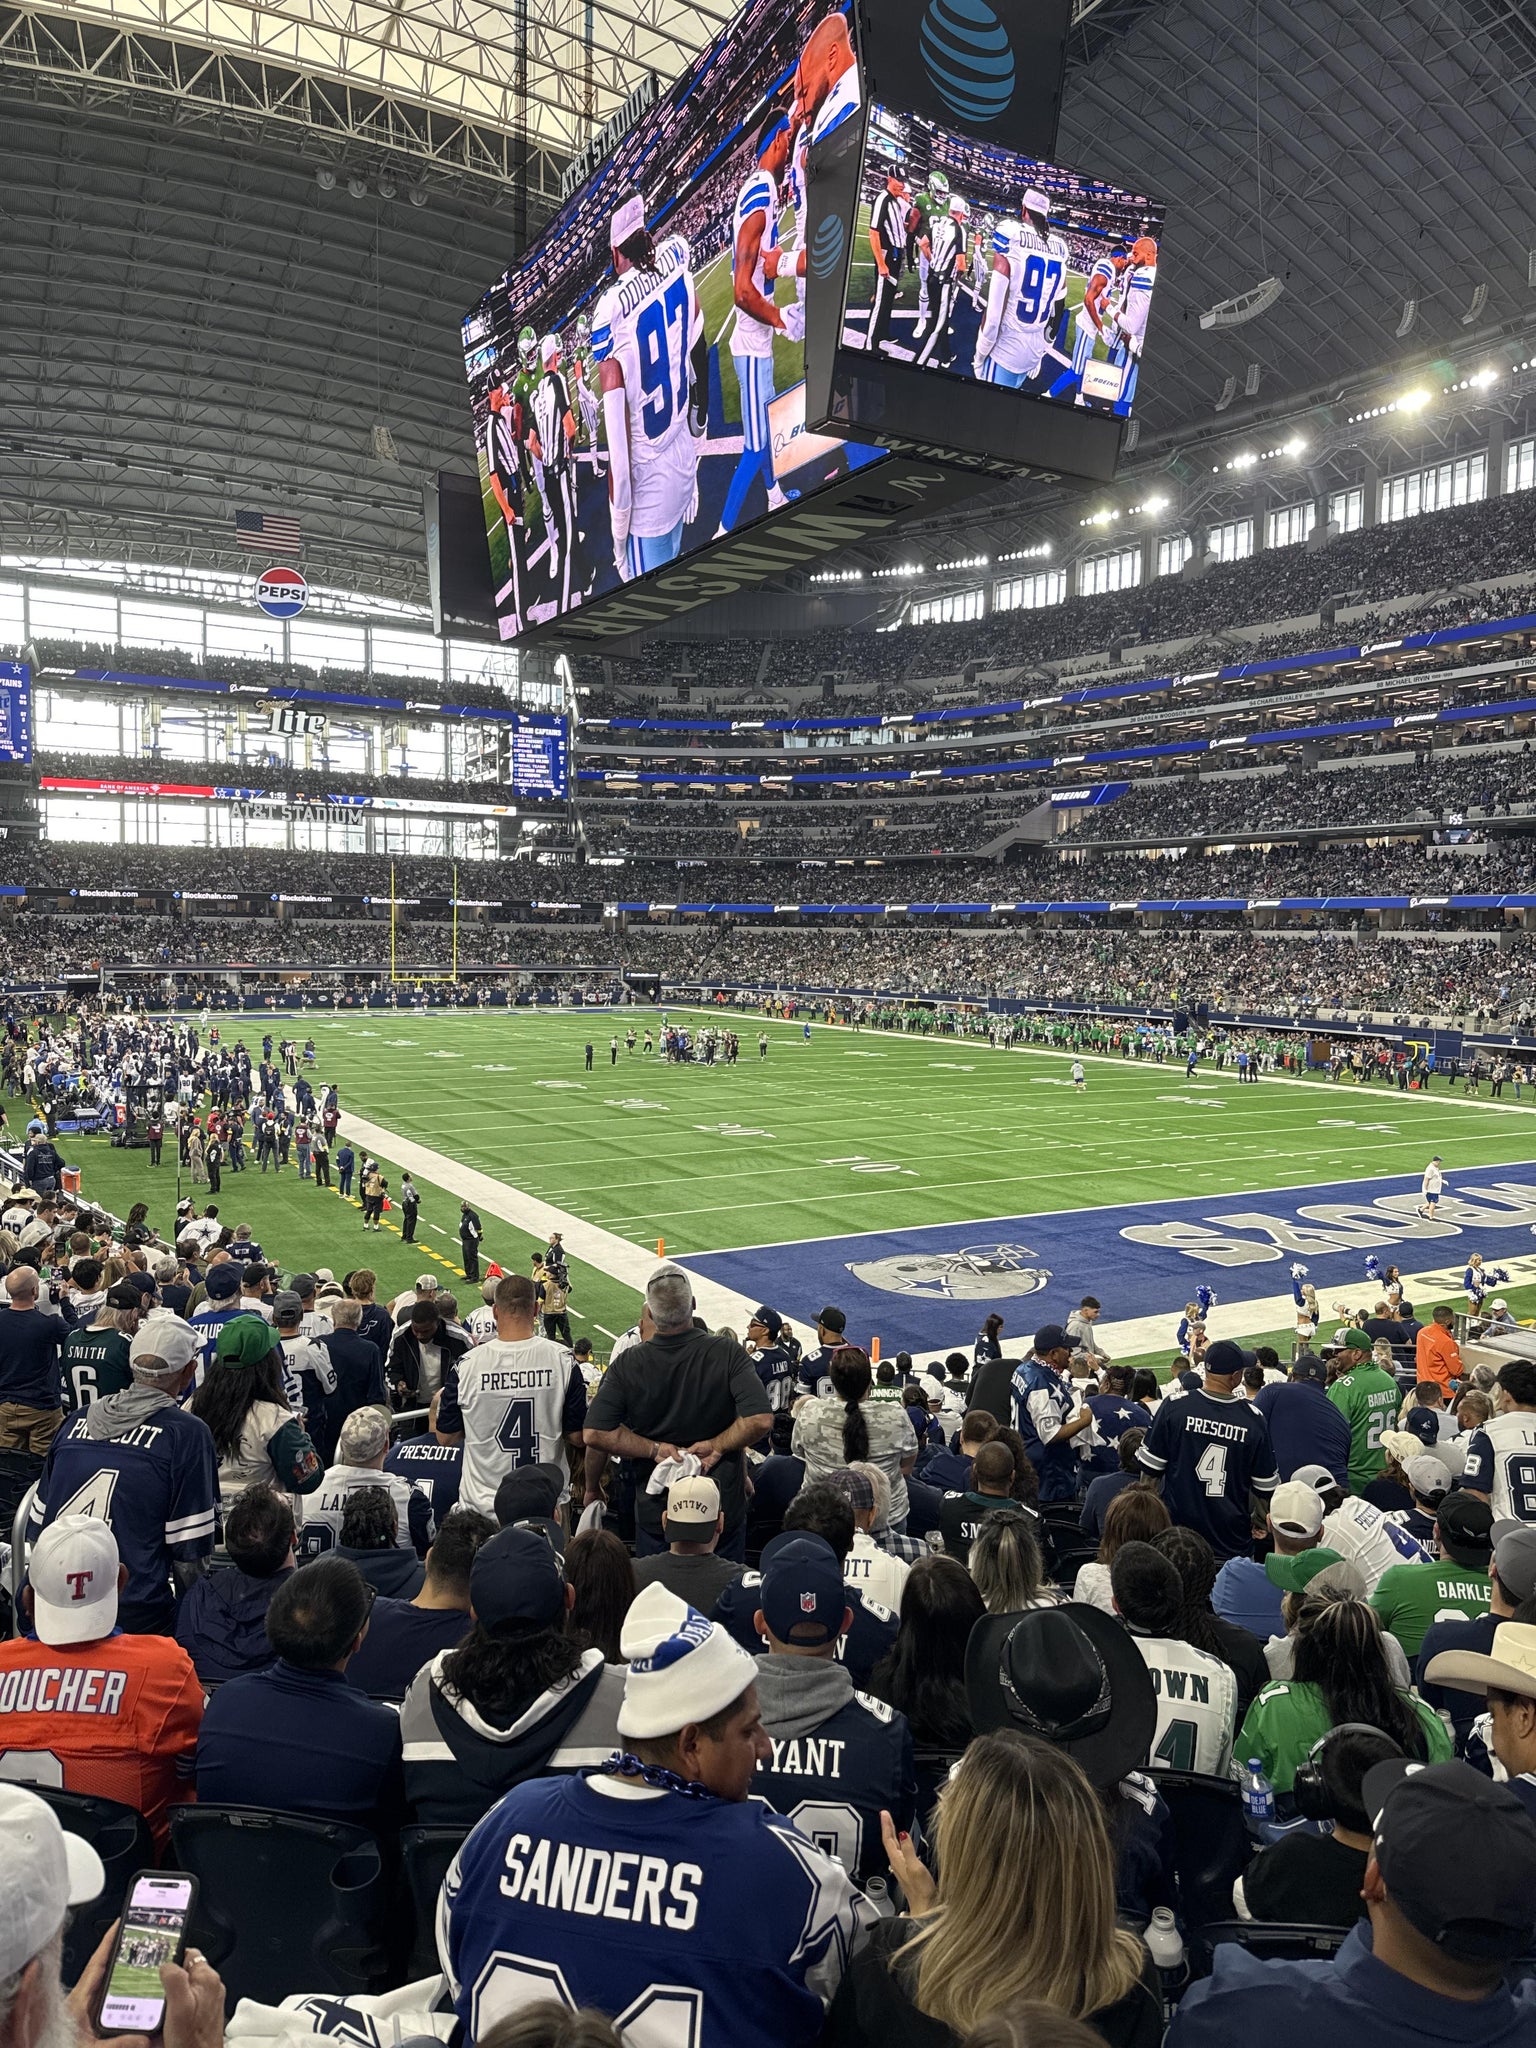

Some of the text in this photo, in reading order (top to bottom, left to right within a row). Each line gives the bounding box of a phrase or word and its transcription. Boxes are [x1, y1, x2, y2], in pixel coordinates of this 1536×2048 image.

[562, 73, 655, 201] AT&T STADIUM
[1016, 254, 1062, 325] 97
[636, 273, 689, 440] 97
[1092, 376, 1120, 388] BOEING
[873, 435, 1063, 484] WINSTAR
[575, 513, 897, 641] WINSTAR
[258, 584, 306, 601] PEPSI
[0, 678, 23, 688] TAINS
[1385, 677, 1412, 687] MICHAEL
[1413, 674, 1431, 683] IRVIN
[1257, 696, 1283, 706] CHARLES
[1283, 693, 1304, 702] HALEY
[267, 707, 326, 738] Lite
[1137, 713, 1159, 722] DARREN
[1160, 709, 1187, 719] WOODSON
[269, 791, 288, 800] 1:55
[229, 802, 363, 826] AT&T STADIUM
[79, 889, 138, 898] Blockchain.com
[182, 891, 238, 900] Blockchain.com
[279, 894, 332, 903] Blockchain.com
[456, 899, 502, 907] Blockchain.com
[538, 901, 581, 909] Blockchain.com
[815, 1155, 901, 1173] 10
[67, 1345, 107, 1360] SMITH
[771, 1361, 789, 1375] LAMB
[71, 1365, 98, 1405] 6
[480, 1369, 553, 1391] PRESCOTT
[1367, 1388, 1397, 1408] BARKLEY
[495, 1397, 540, 1470] 4
[1185, 1415, 1248, 1443] PRESCOTT
[396, 1444, 460, 1461] PRESCOTT
[1195, 1442, 1228, 1497] 4
[1464, 1454, 1482, 1477] 8
[55, 1467, 120, 1531] 4
[672, 1500, 708, 1515] DALLAS
[66, 1571, 94, 1600] T
[1436, 1581, 1491, 1603] BARKLE
[0, 1668, 128, 1716] OUCHER
[1149, 1667, 1210, 1704] OWN
[755, 1738, 846, 1778] YANT
[1251, 1804, 1267, 1814] BLUE
[499, 1833, 703, 1931] SANDERS
